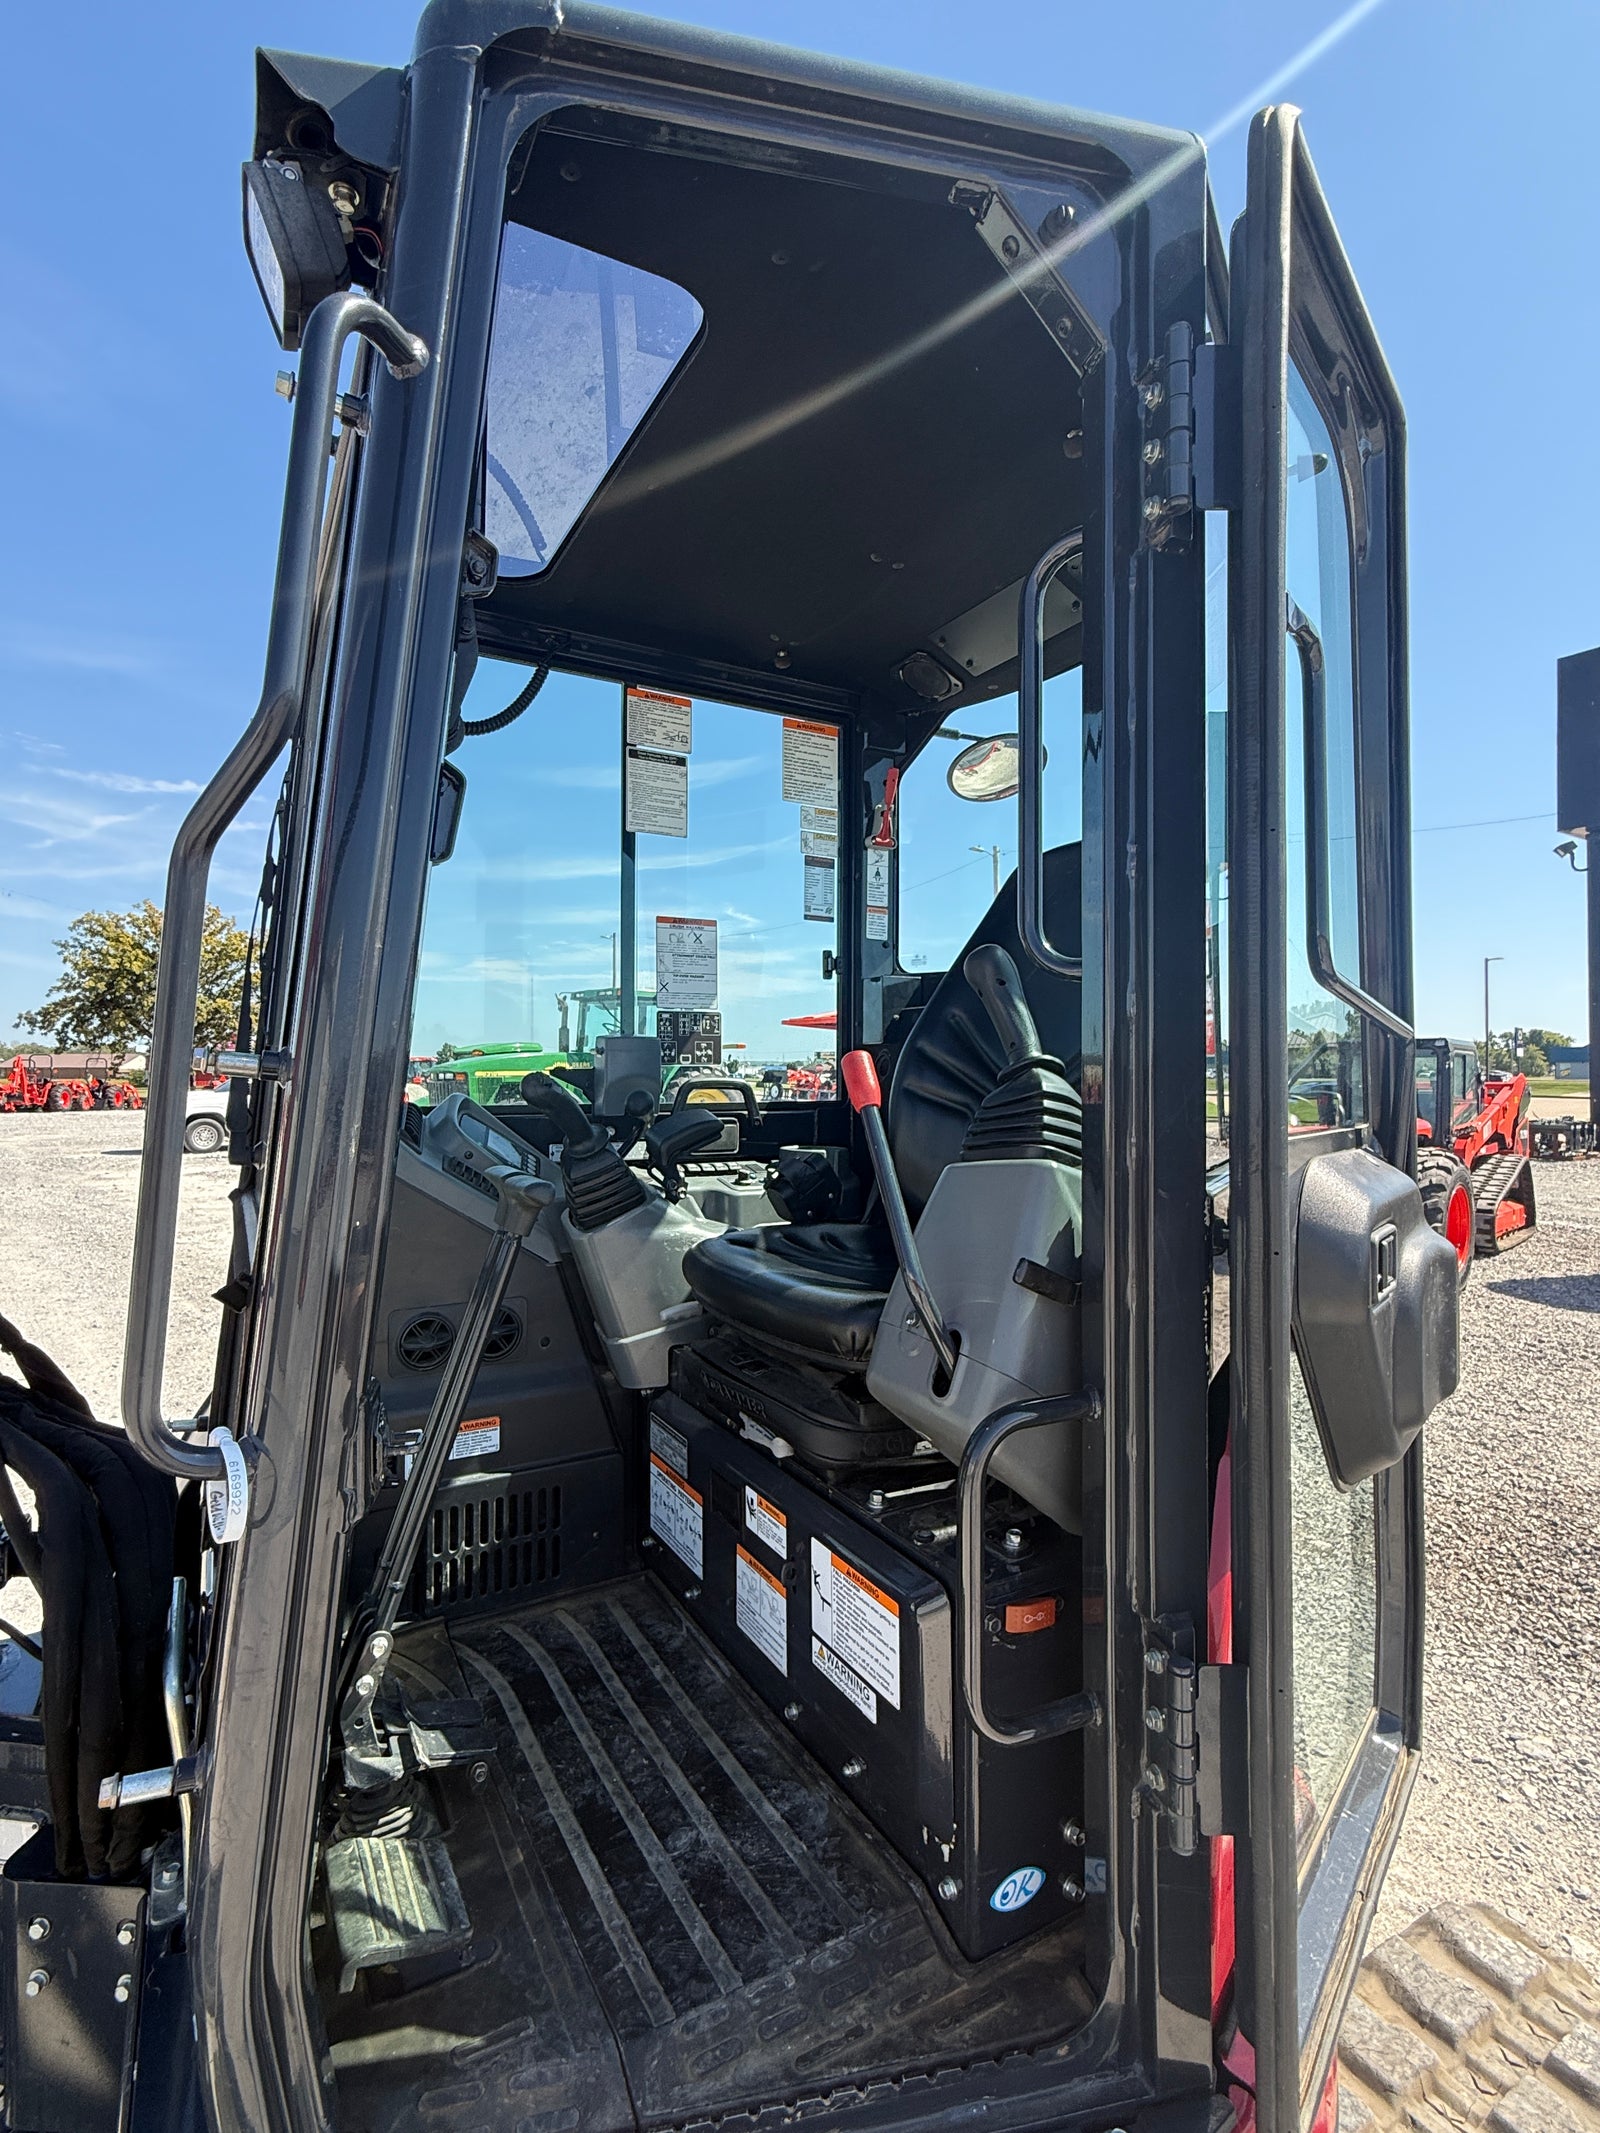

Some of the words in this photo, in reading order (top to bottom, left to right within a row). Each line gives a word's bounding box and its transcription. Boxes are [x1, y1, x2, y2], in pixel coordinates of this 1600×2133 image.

[463, 1419, 497, 1430] WARNING
[228, 1460, 242, 1516] 6169922
[851, 1570, 880, 1599] WARNING
[825, 1649, 871, 1702] WARNING
[1000, 1870, 1035, 1907] OK
